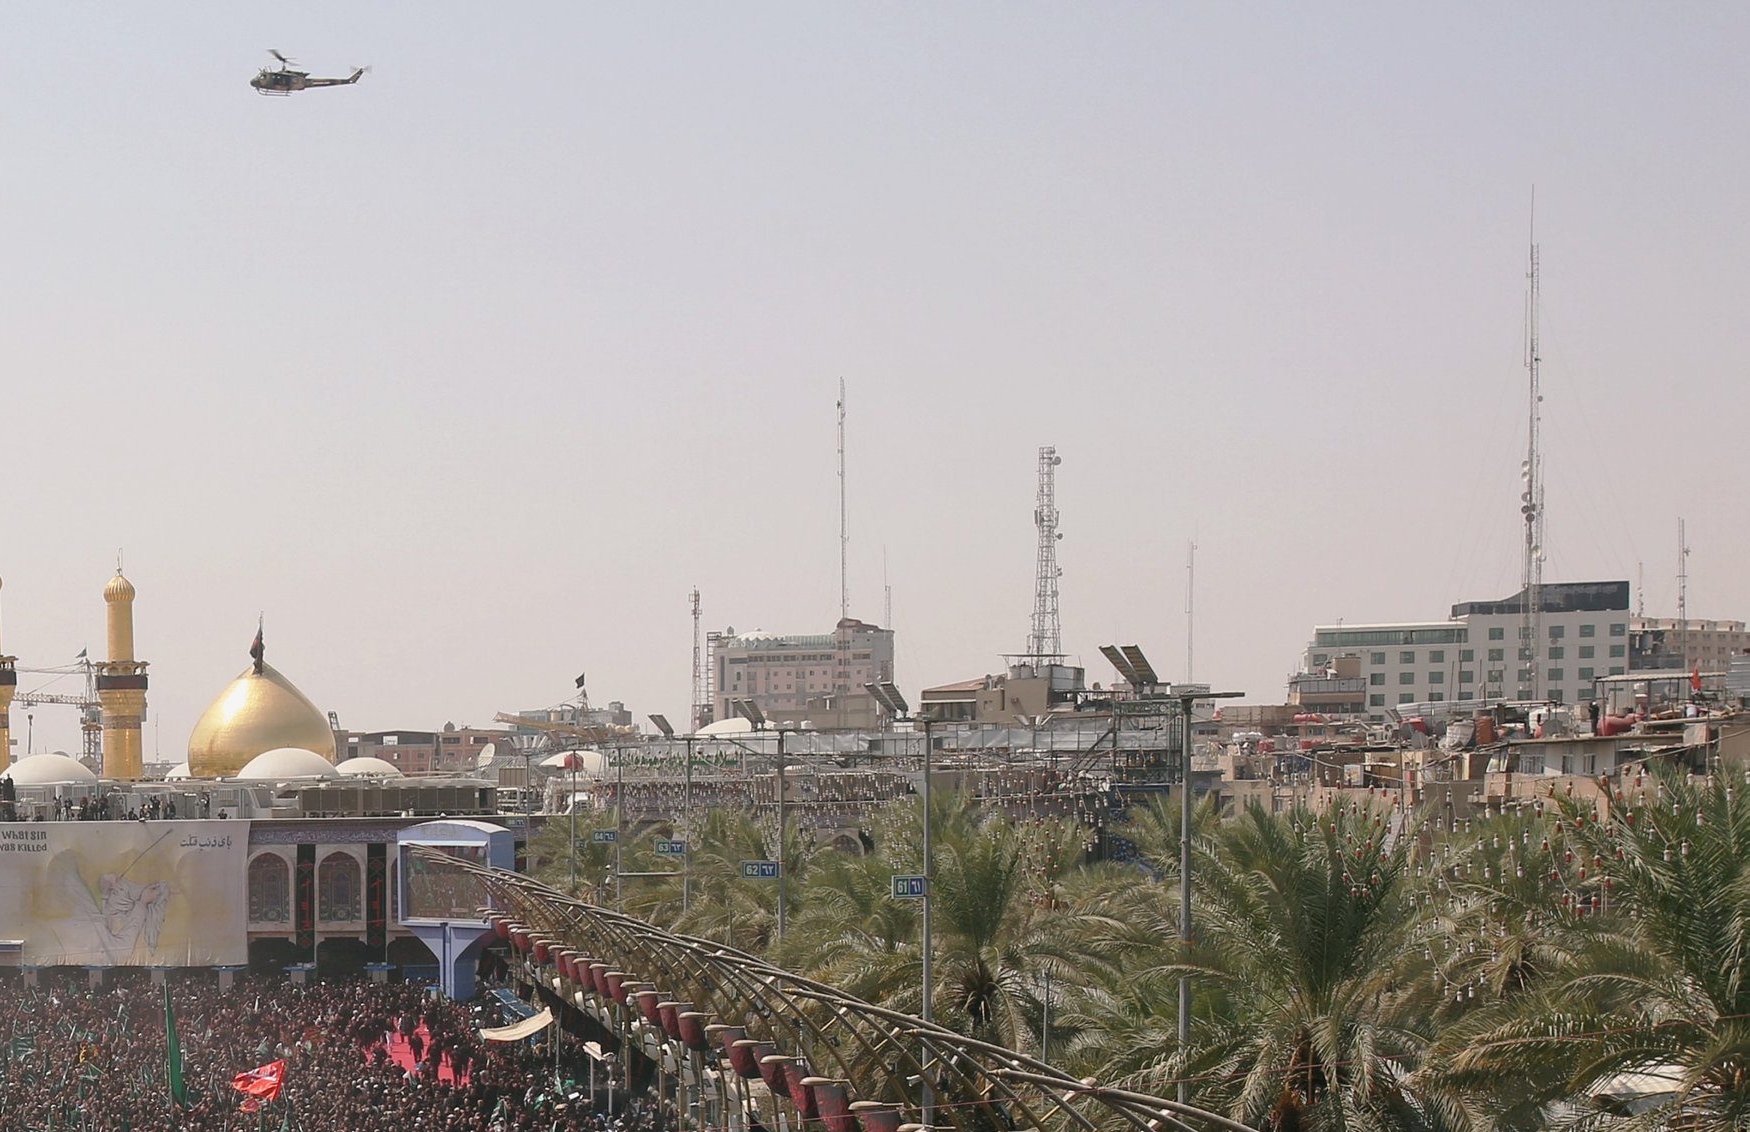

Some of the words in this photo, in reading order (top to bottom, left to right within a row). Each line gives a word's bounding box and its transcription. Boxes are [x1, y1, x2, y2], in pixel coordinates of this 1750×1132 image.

[746, 864, 759, 876] 62
[762, 863, 774, 875] ٦٢
[897, 880, 908, 893] 61
[911, 879, 921, 892] ٦١
